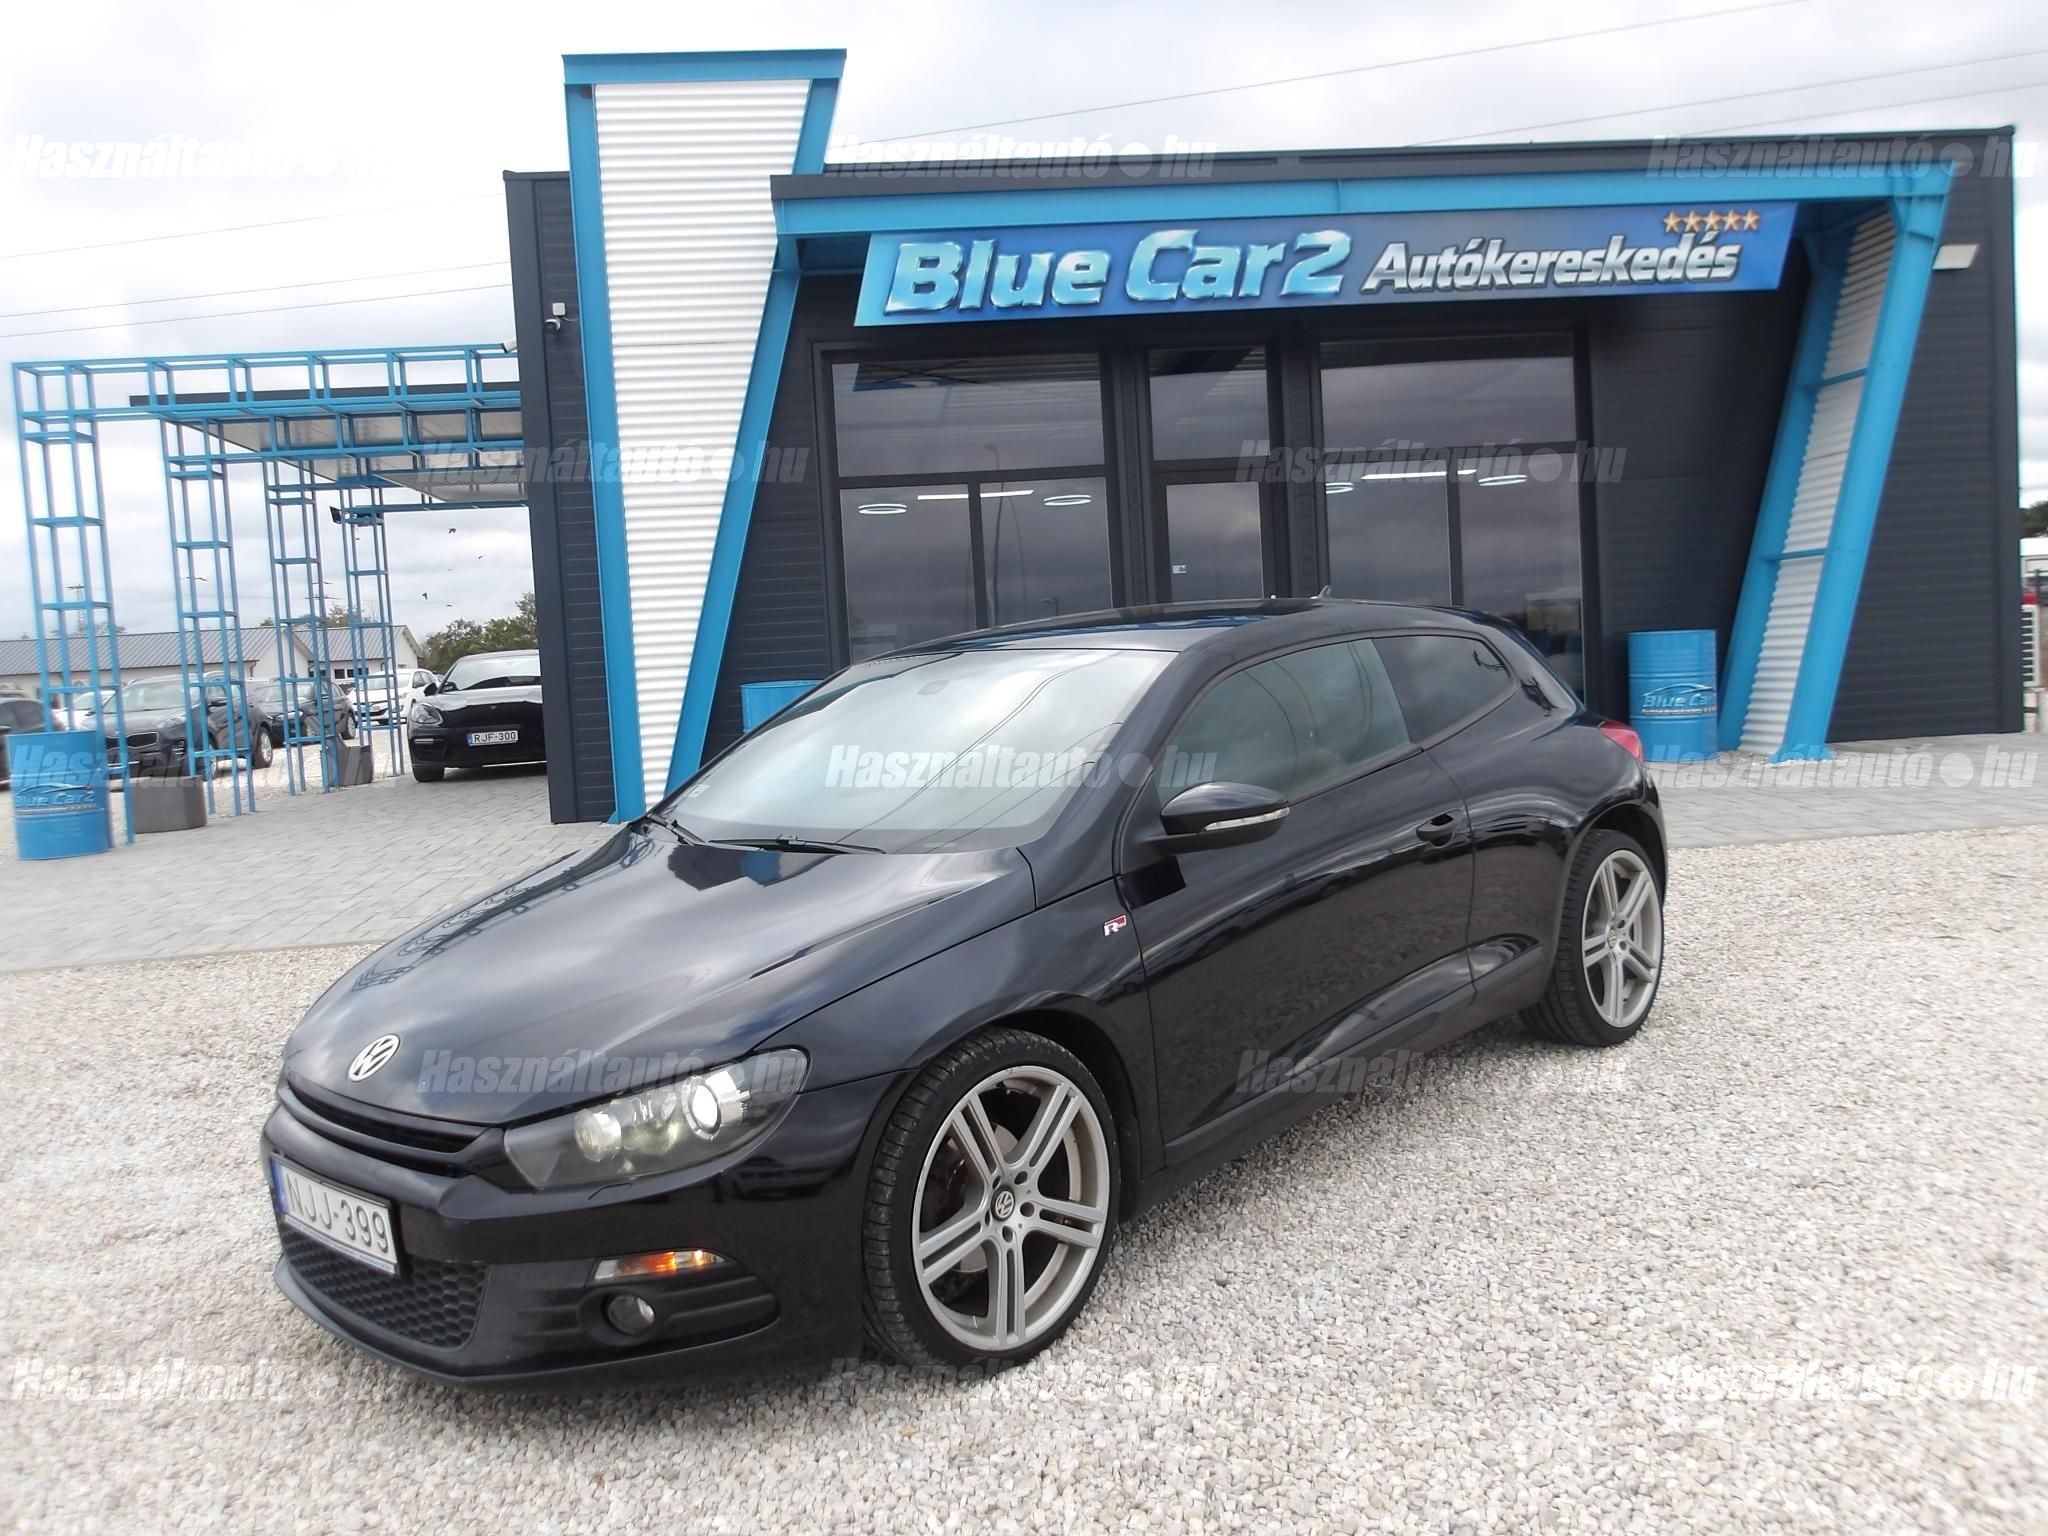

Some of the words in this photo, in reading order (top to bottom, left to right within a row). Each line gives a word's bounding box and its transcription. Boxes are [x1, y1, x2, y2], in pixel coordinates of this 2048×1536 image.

[884, 240, 1111, 317] Blue
[1125, 228, 1351, 302] Car2
[1361, 231, 1742, 295] Autókereskedés
[1642, 695, 1686, 707] Blue
[474, 732, 516, 742] RJF-300
[15, 795, 49, 806] Blue
[286, 1173, 389, 1254] NJJ-399
